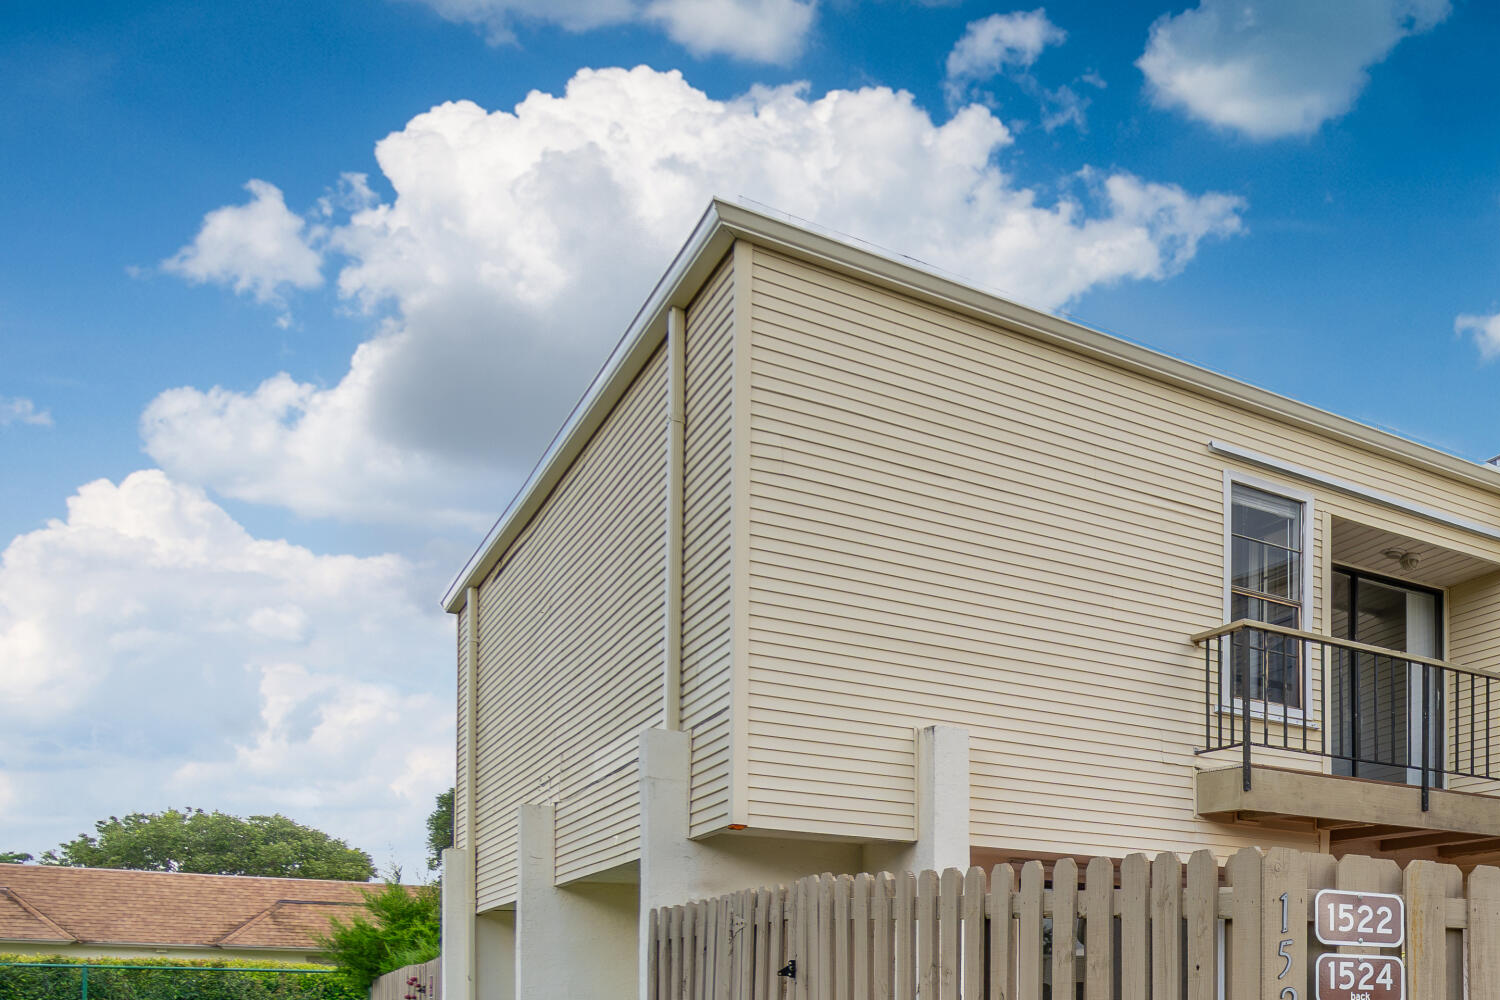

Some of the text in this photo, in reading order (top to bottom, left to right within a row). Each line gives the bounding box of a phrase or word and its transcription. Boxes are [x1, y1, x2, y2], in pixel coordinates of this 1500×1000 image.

[1328, 902, 1392, 934] 1522
[1328, 961, 1393, 991] 1524
[1350, 992, 1371, 1000] back
